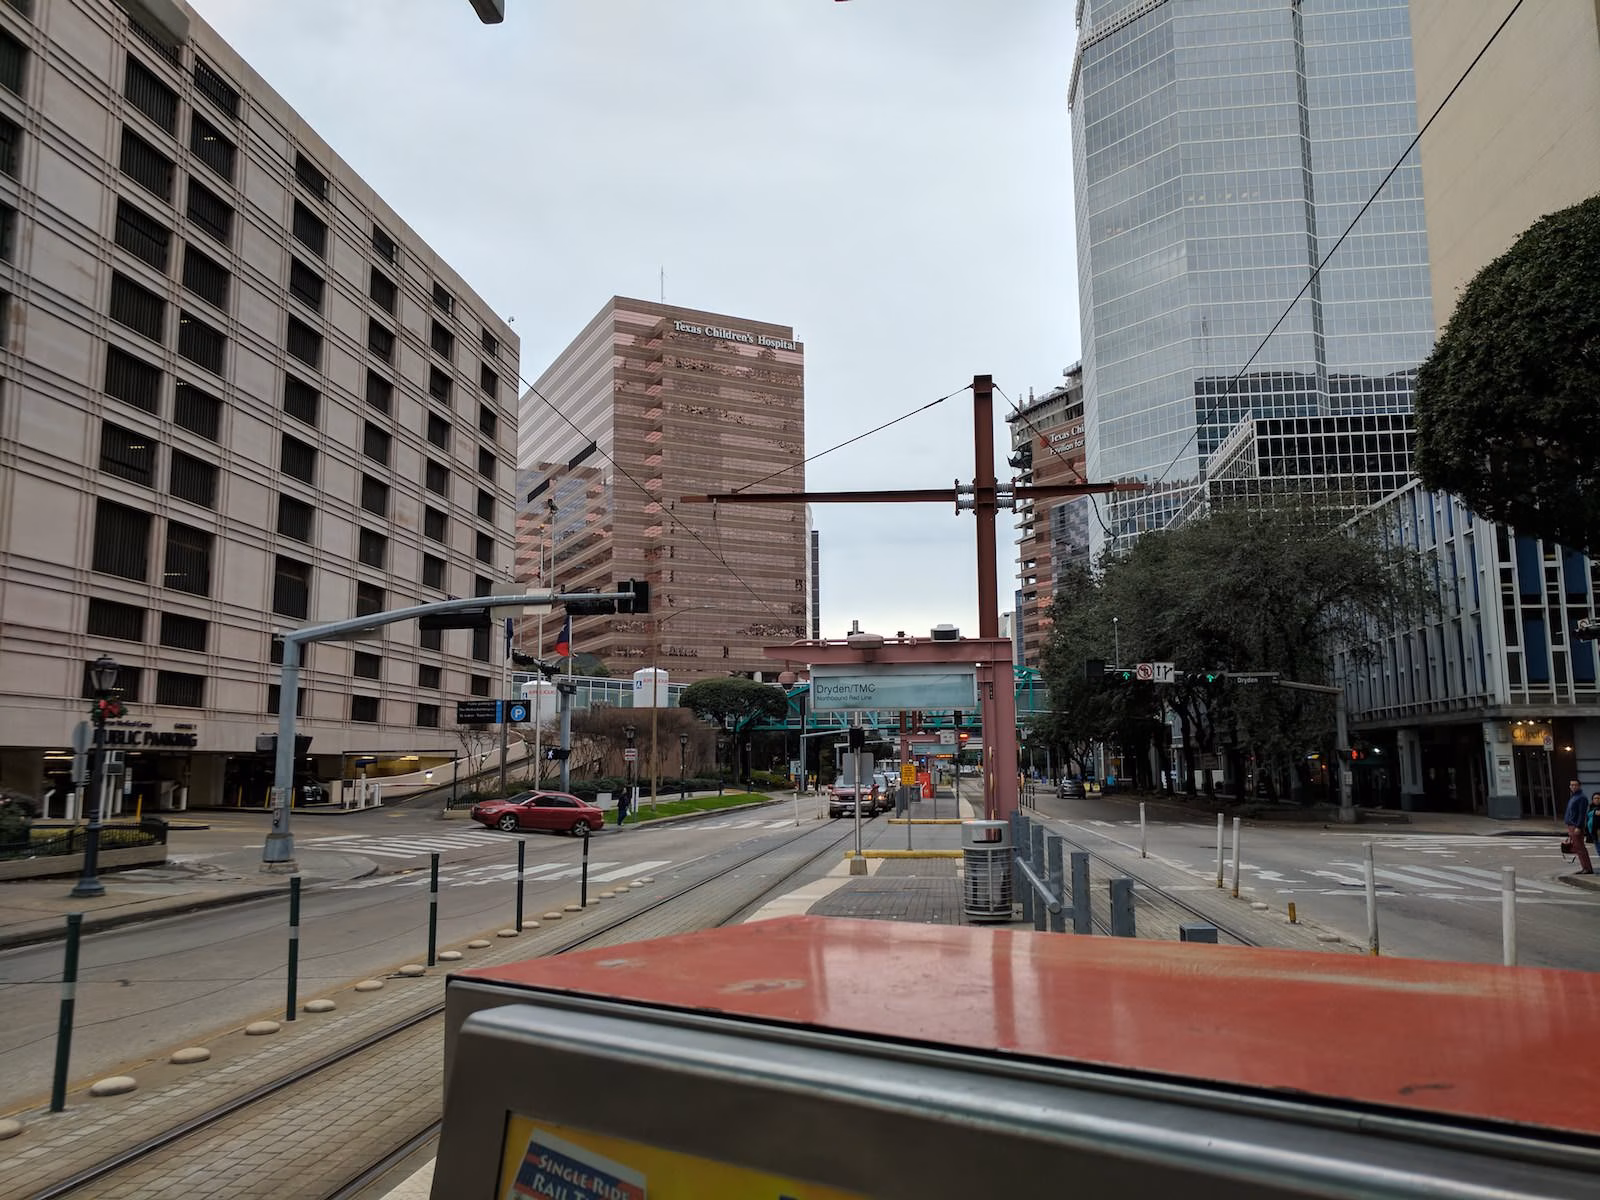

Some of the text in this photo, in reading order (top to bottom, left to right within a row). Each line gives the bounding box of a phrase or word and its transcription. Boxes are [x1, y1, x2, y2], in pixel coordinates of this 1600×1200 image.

[674, 320, 796, 351] Texas Children's Hospital
[1050, 429, 1070, 443] Texas
[816, 683, 876, 695] Dryden/TMC
[1237, 677, 1259, 685] Dryden
[144, 730, 197, 747] PARKING
[538, 1154, 588, 1188] SINGLE
[532, 1173, 568, 1200] RAIL
